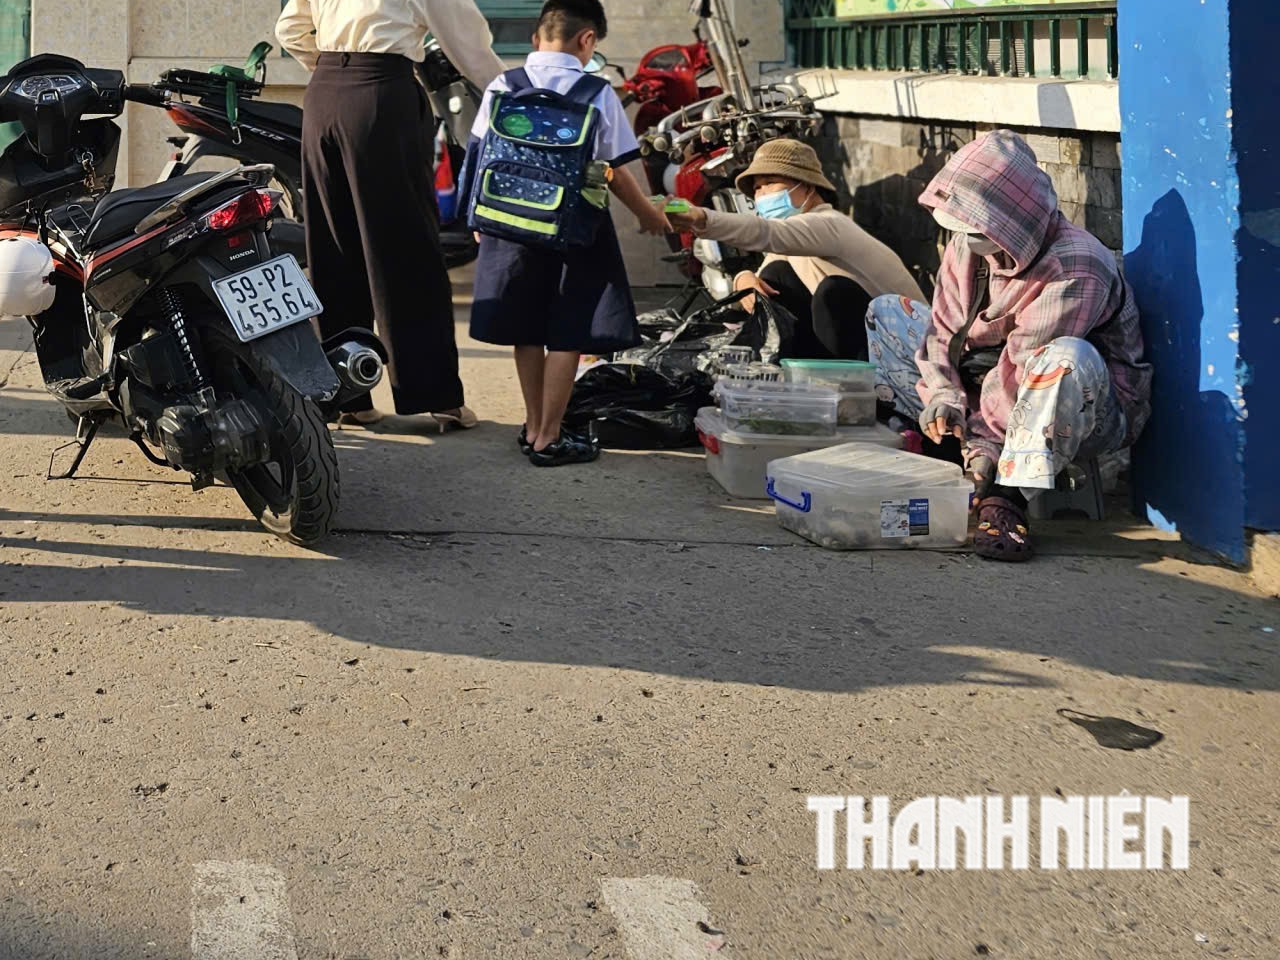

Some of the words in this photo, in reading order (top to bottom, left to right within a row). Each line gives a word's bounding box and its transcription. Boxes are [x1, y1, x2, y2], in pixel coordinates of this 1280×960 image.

[229, 249, 255, 261] HONDA
[227, 263, 293, 304] 59-P2
[236, 287, 316, 334] 455.64
